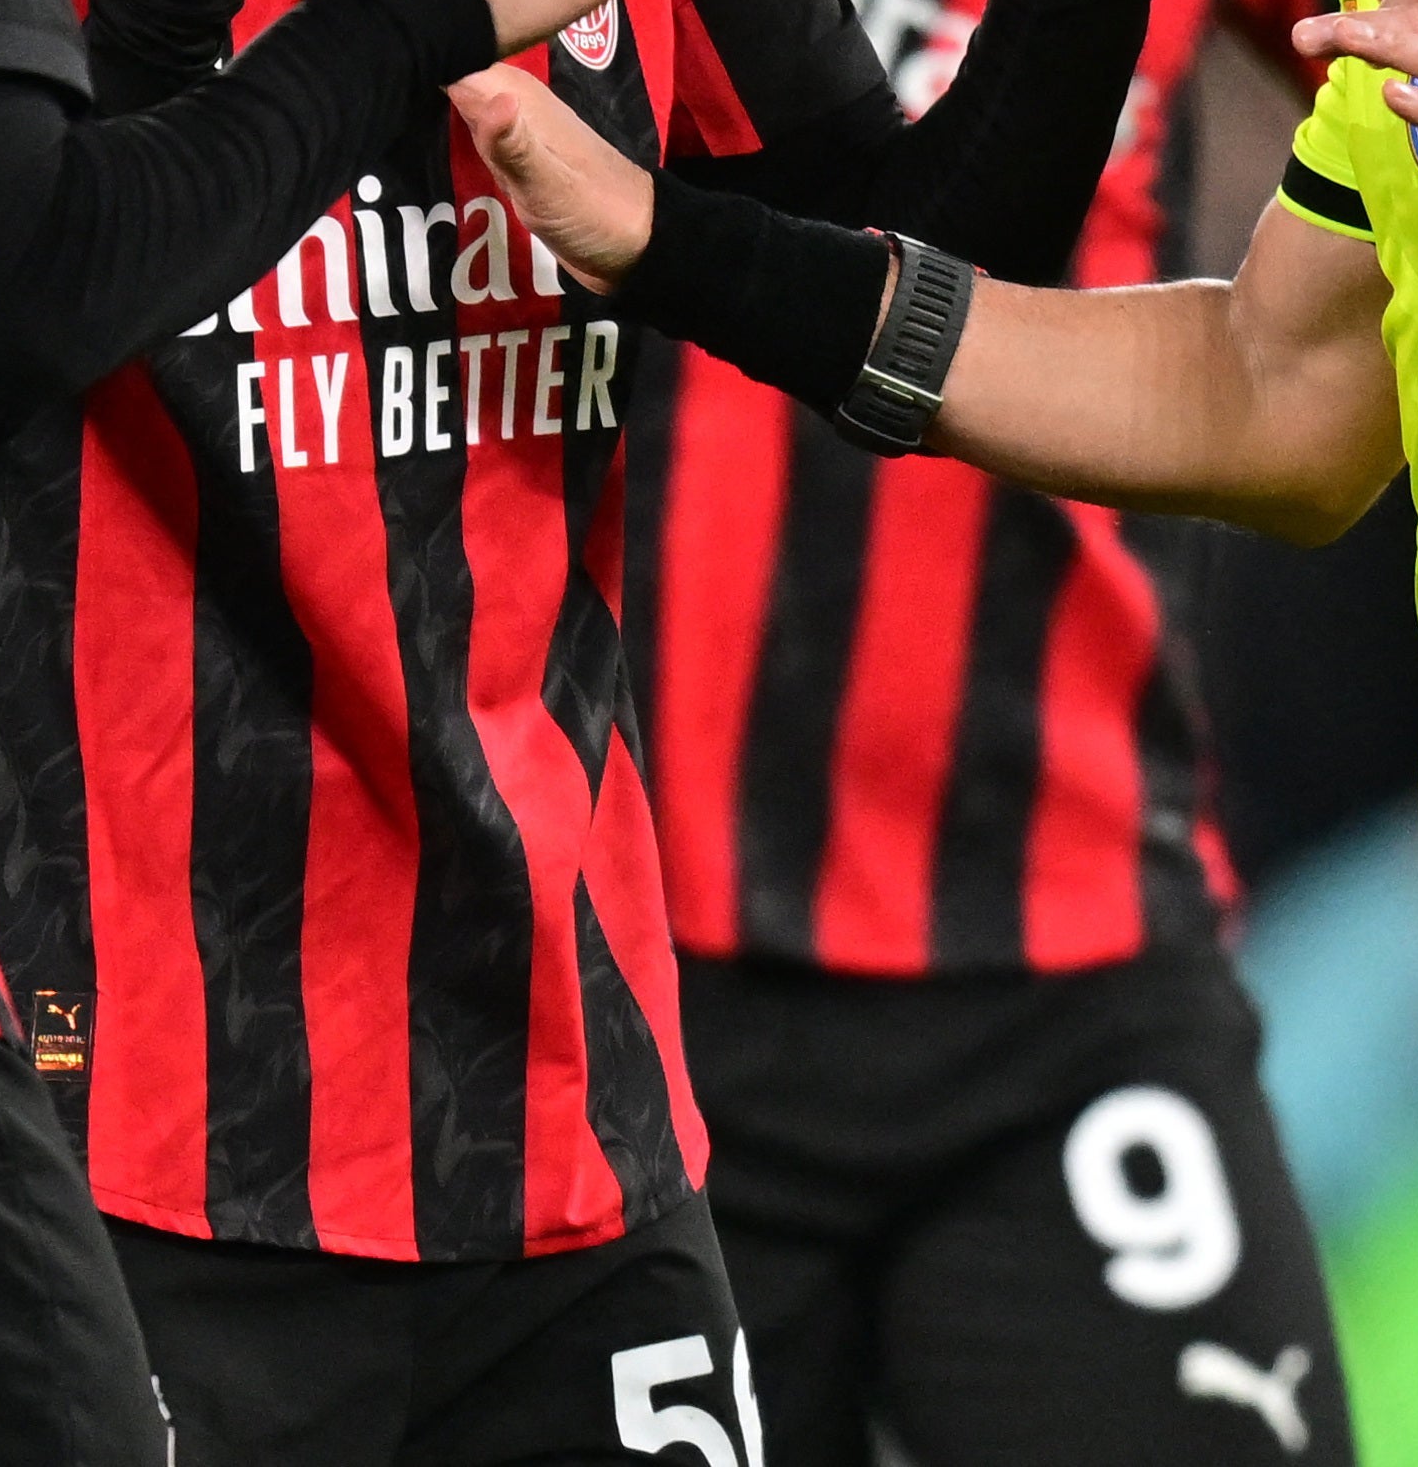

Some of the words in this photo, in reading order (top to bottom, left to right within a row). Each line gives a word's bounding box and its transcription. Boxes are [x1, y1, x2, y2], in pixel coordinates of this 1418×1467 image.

[572, 31, 606, 50] 1899
[236, 352, 349, 474] FLY
[381, 319, 620, 459] BETTER
[1063, 1084, 1243, 1313] 9
[610, 1328, 763, 1467] 5
